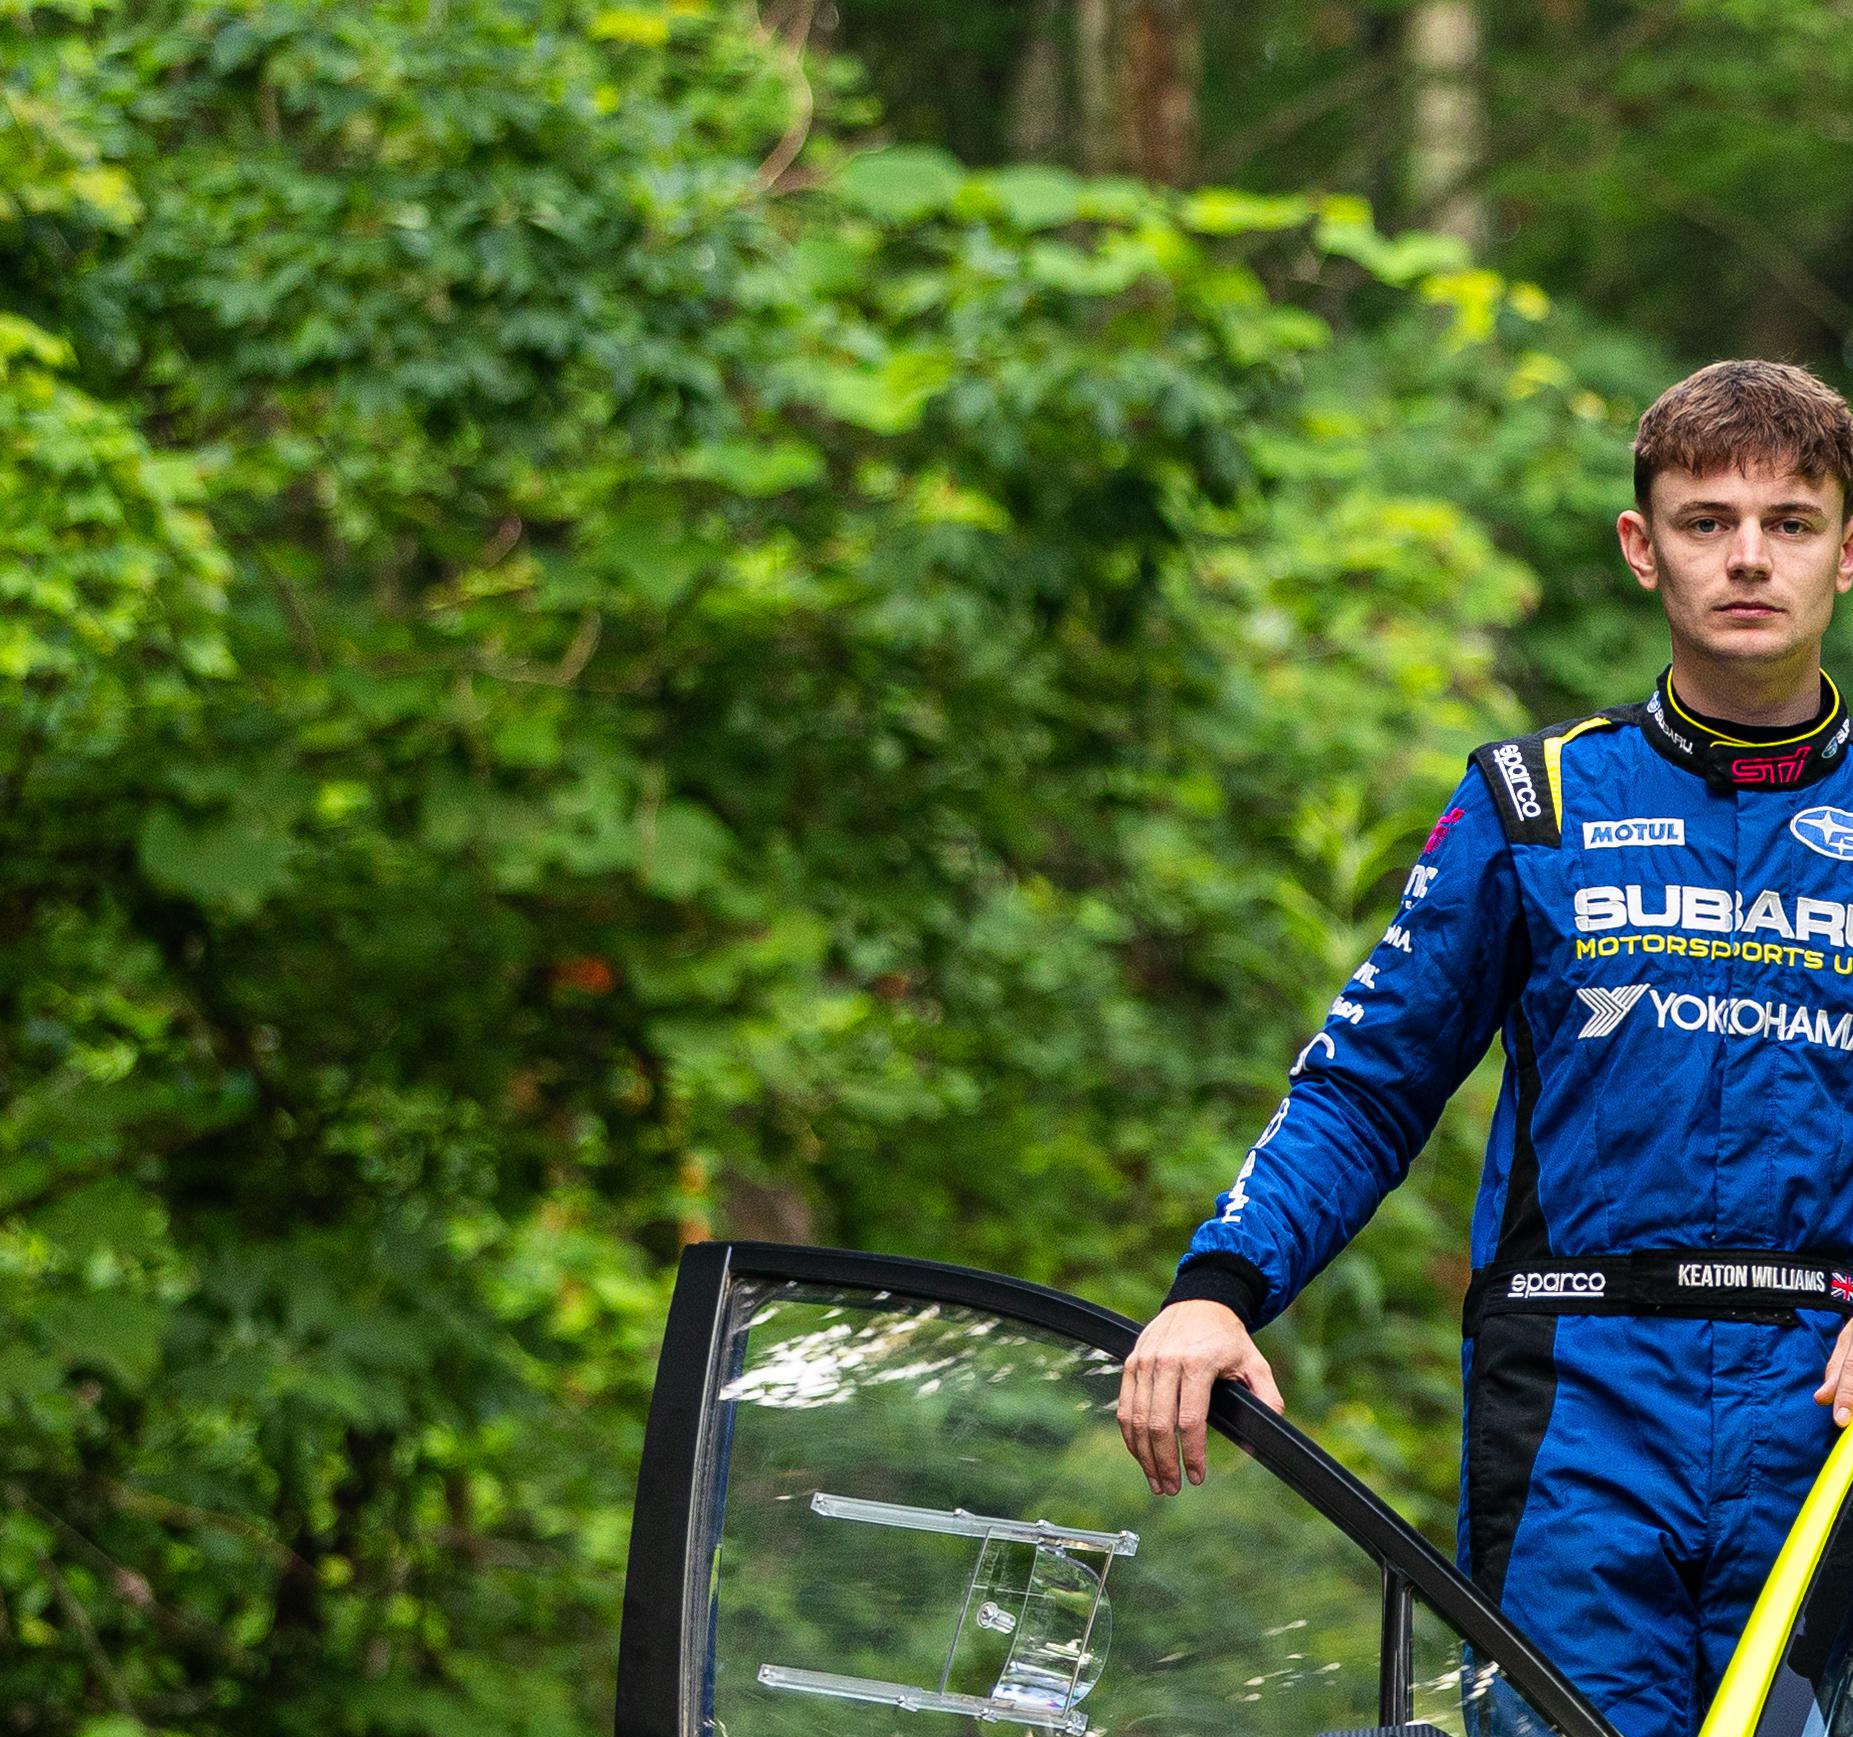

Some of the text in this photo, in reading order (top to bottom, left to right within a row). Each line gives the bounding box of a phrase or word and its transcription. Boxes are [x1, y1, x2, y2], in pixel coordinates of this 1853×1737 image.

[1493, 743, 1542, 821] sparco
[1590, 823, 1679, 844] MOTUL
[1576, 934, 1824, 970] MOTORSPORTS
[1507, 1271, 1607, 1299] sparco
[1678, 1263, 1826, 1293] KEATON WILLIAMS
